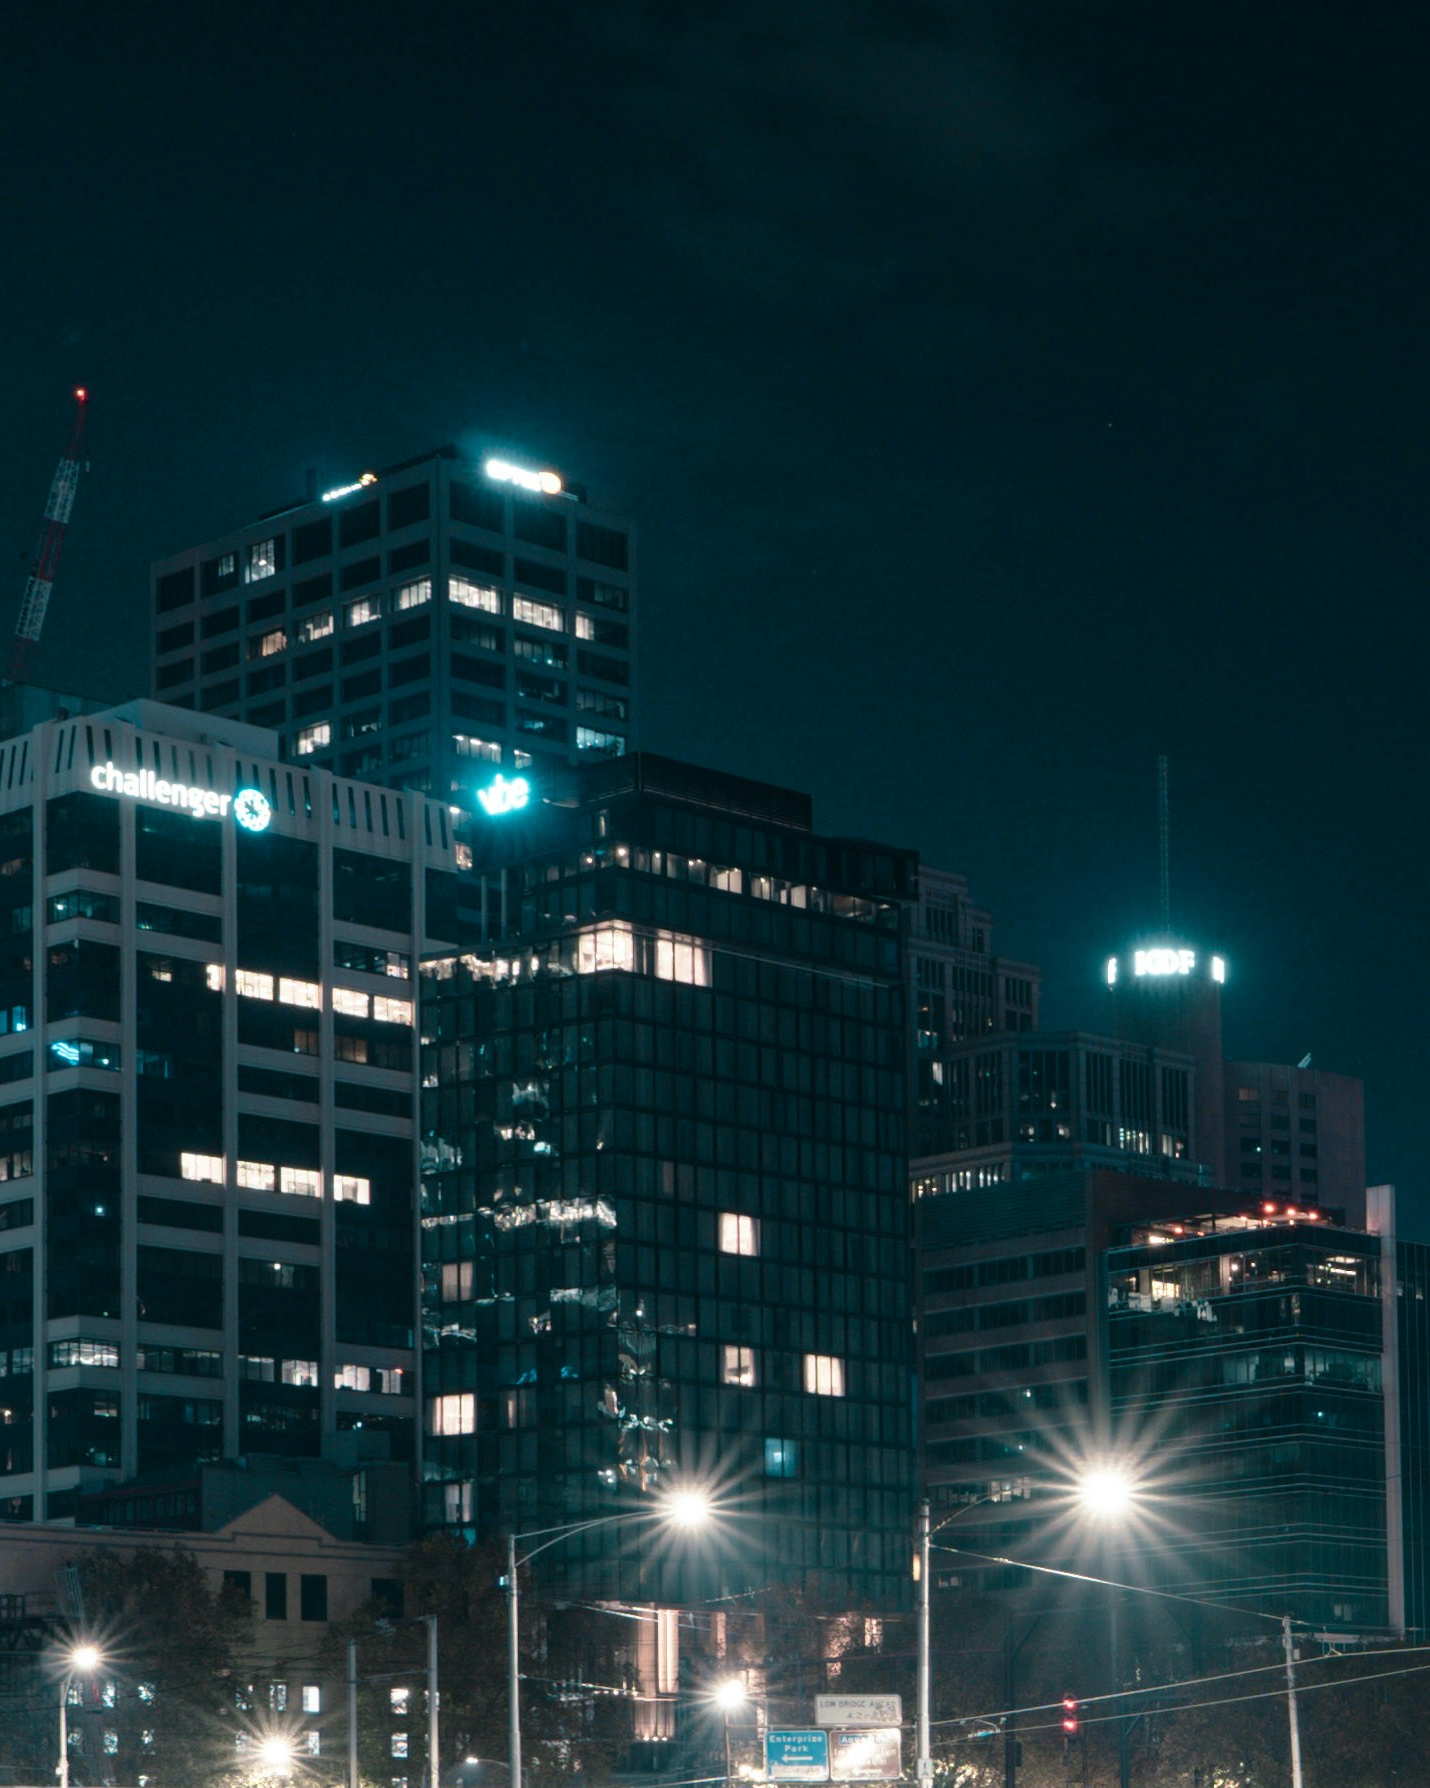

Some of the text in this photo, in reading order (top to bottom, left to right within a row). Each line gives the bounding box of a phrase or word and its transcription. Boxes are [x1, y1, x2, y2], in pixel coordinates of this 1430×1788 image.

[91, 761, 232, 818] challenger
[769, 1734, 823, 1744] Enterprize
[784, 1744, 809, 1753] Park
